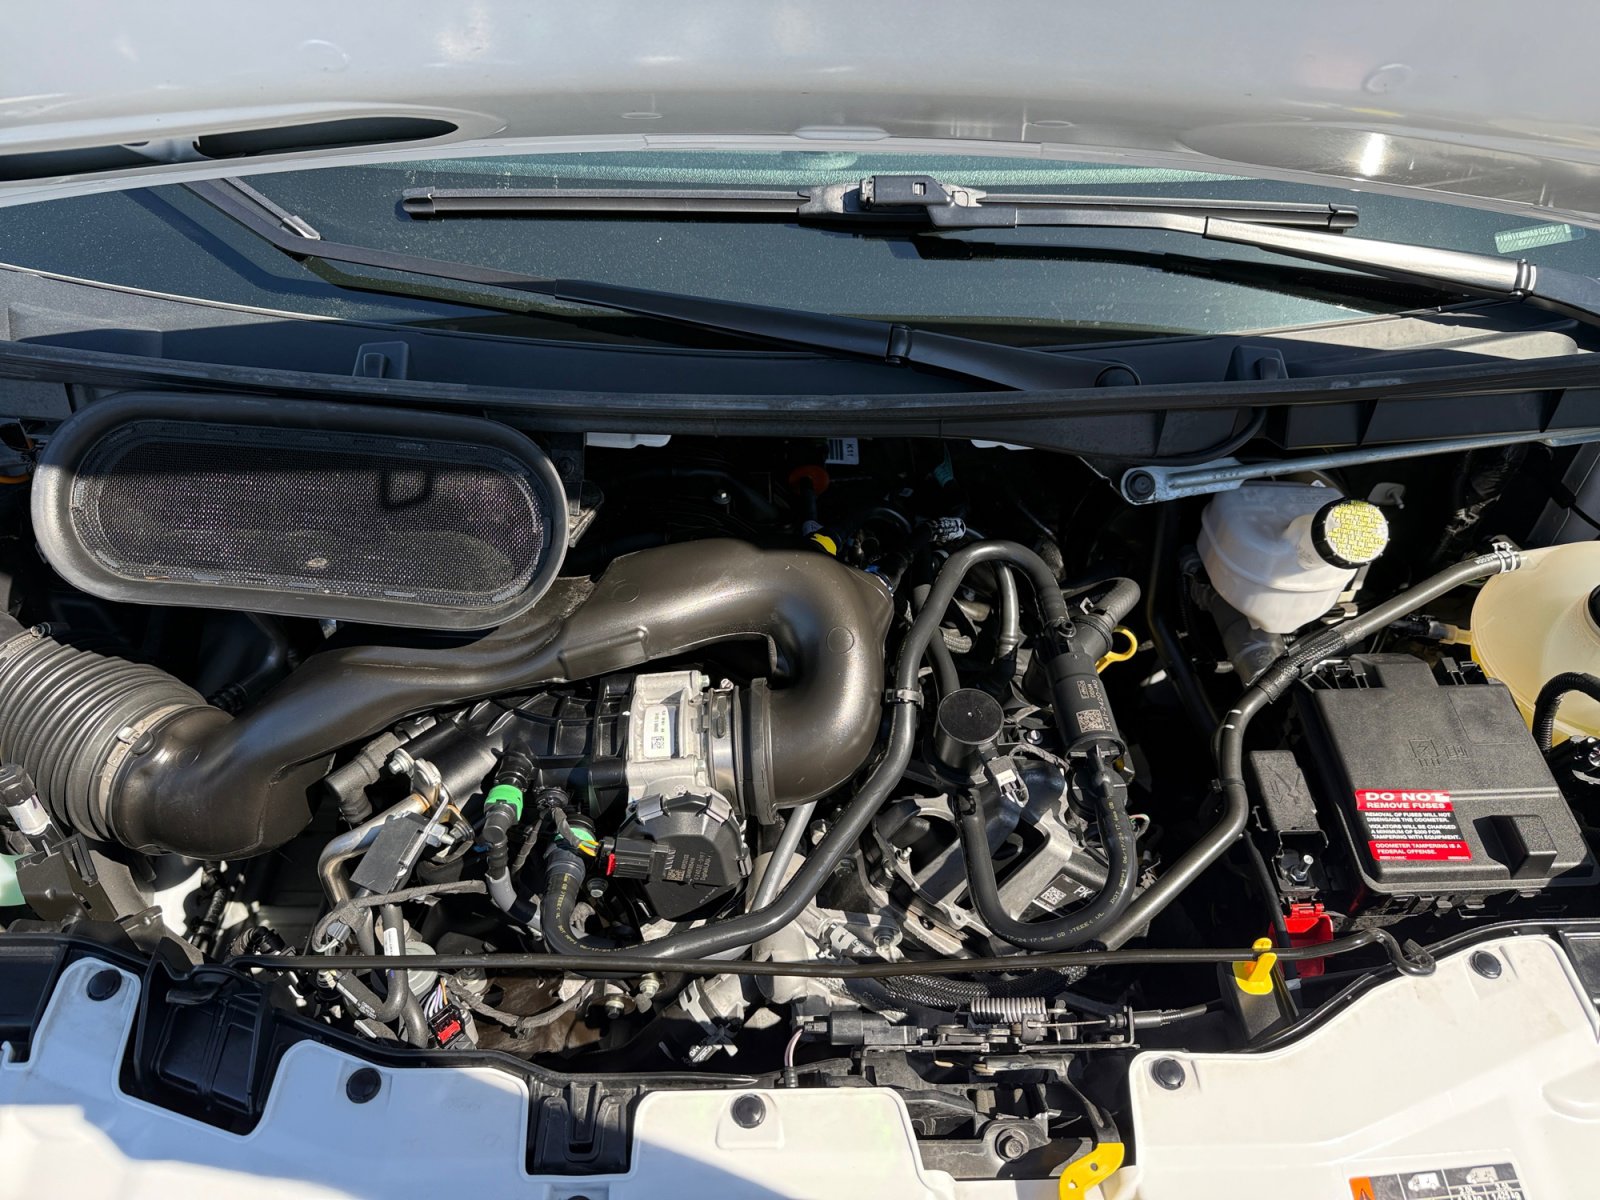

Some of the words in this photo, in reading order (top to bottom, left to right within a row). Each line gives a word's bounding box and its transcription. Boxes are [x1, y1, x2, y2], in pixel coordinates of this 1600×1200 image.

[1365, 792, 1396, 801] DO
[1401, 792, 1446, 801] NOT
[1073, 885, 1093, 898] PK
[1109, 890, 1120, 904] DOT
